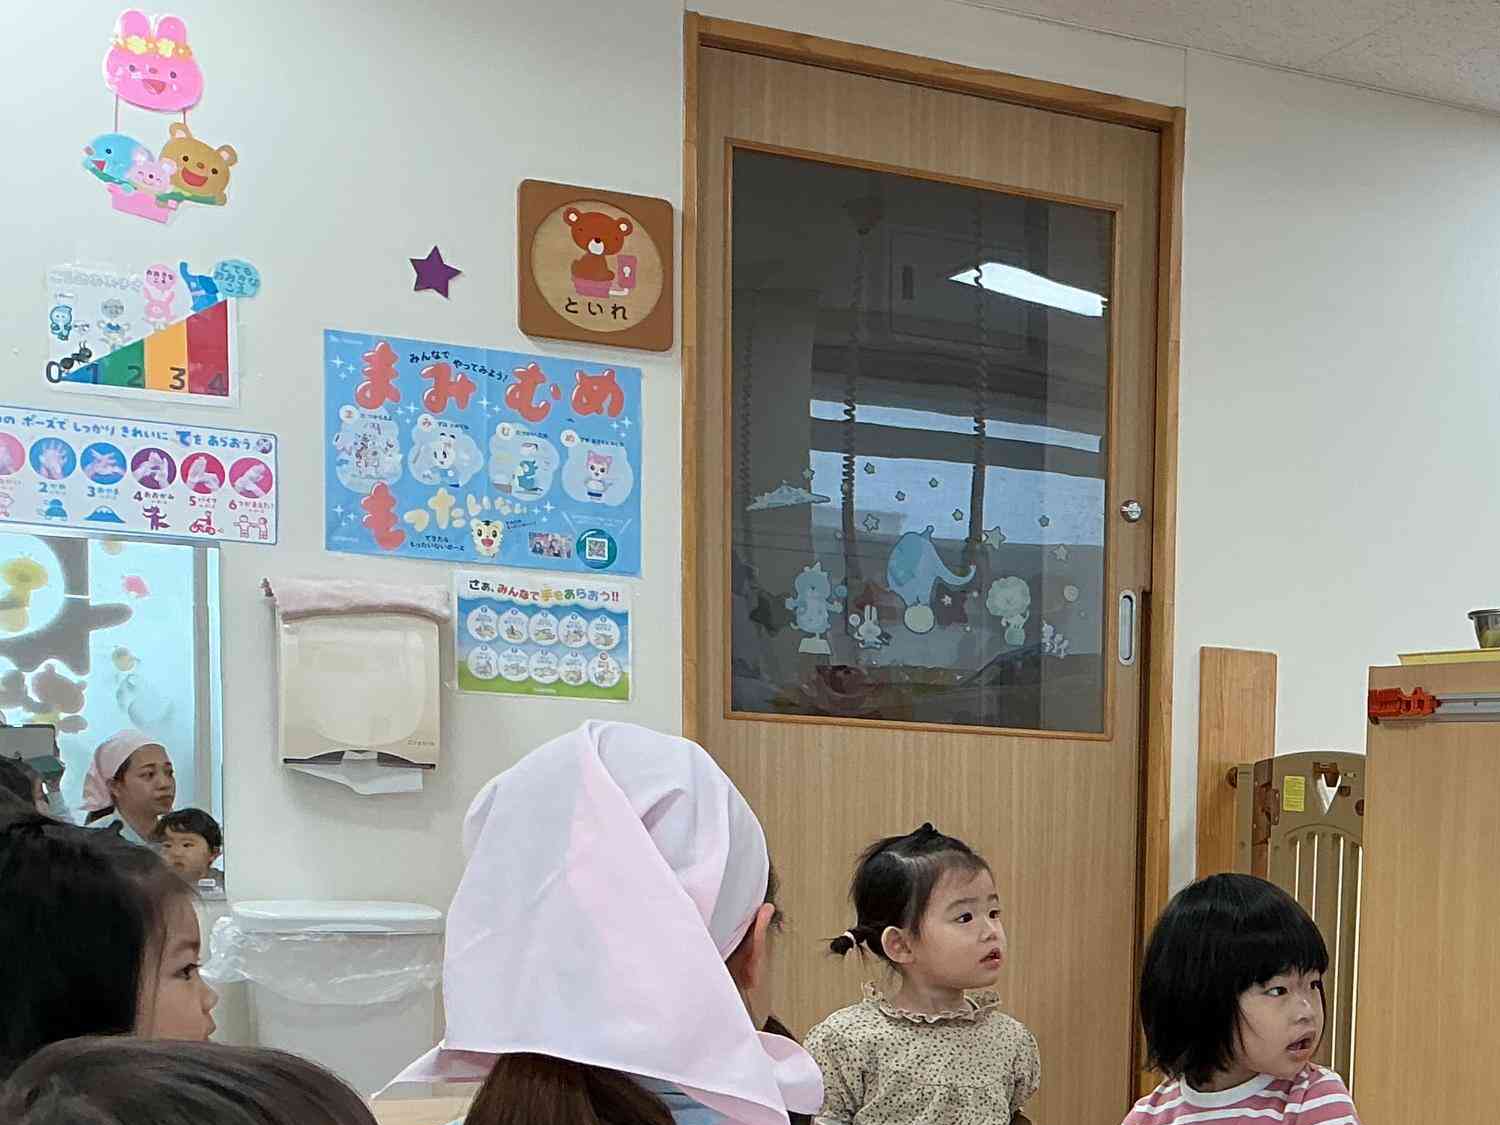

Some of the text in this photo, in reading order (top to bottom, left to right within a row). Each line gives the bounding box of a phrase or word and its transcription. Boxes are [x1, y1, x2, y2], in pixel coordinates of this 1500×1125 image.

[565, 297, 628, 320] といれ
[409, 350, 450, 364] みんなで
[46, 361, 62, 383] 0
[128, 366, 143, 387] 2
[169, 366, 186, 390] 3
[0, 416, 16, 425] の
[73, 422, 115, 436] しっかり
[121, 426, 168, 440] きれいに
[176, 430, 202, 447] てを
[207, 434, 250, 450] あらおう
[39, 482, 48, 493] 2
[88, 486, 95, 497] 3
[134, 491, 143, 501] 4
[189, 496, 197, 506] 5
[229, 500, 238, 510] 6
